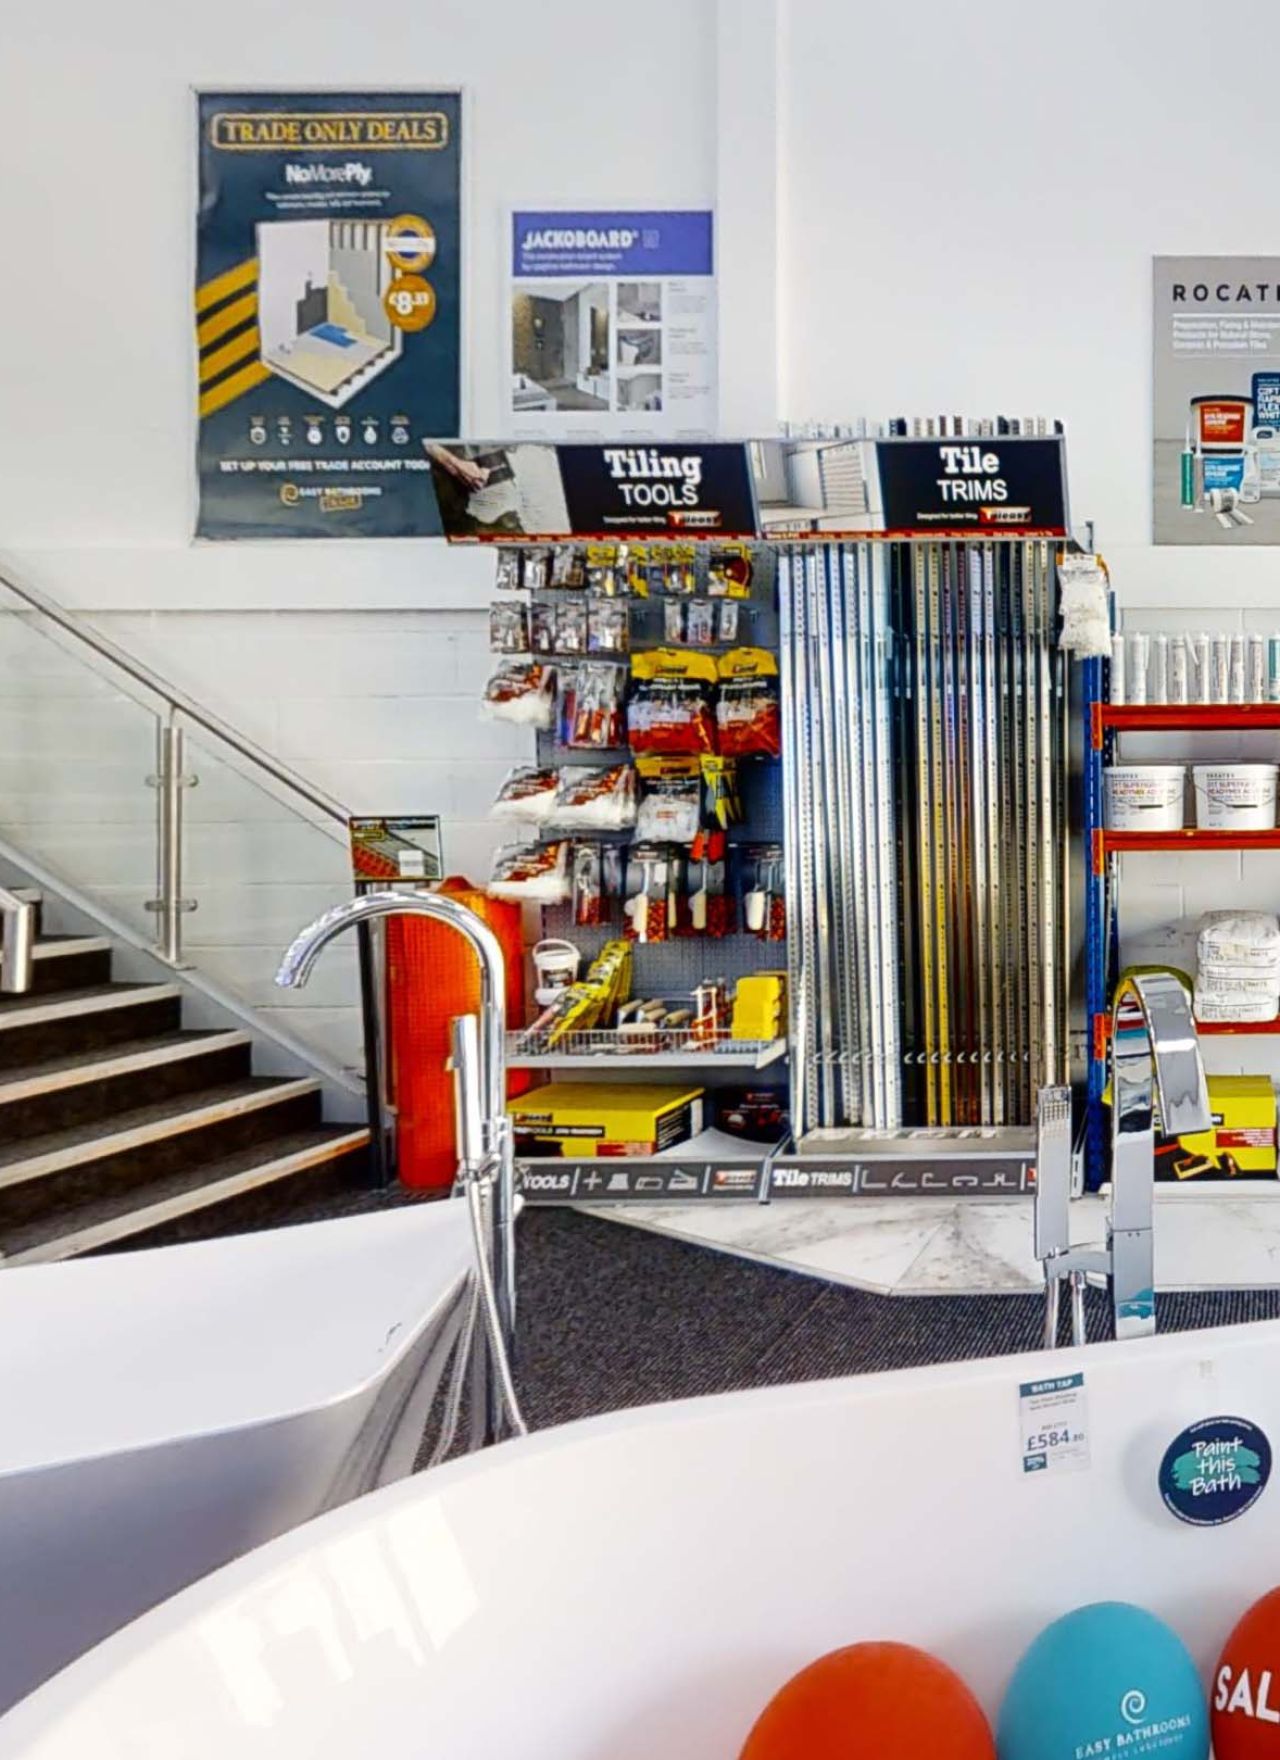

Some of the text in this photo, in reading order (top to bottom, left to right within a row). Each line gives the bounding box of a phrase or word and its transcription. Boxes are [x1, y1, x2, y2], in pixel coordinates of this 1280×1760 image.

[223, 120, 437, 141] TRADE ONLY DEALS
[603, 449, 702, 485] Tiling
[939, 446, 1000, 474] Tile
[618, 484, 699, 506] TOOLS
[936, 479, 1008, 502] TRIMS
[773, 1169, 852, 1186] Tile TRIMS
[1031, 1379, 1073, 1393] BATH TAP
[1192, 1436, 1243, 1458] Paint
[1196, 1455, 1235, 1475] this
[1189, 1472, 1241, 1496] Bath
[1075, 1714, 1191, 1759] EASY BATHROOMS
